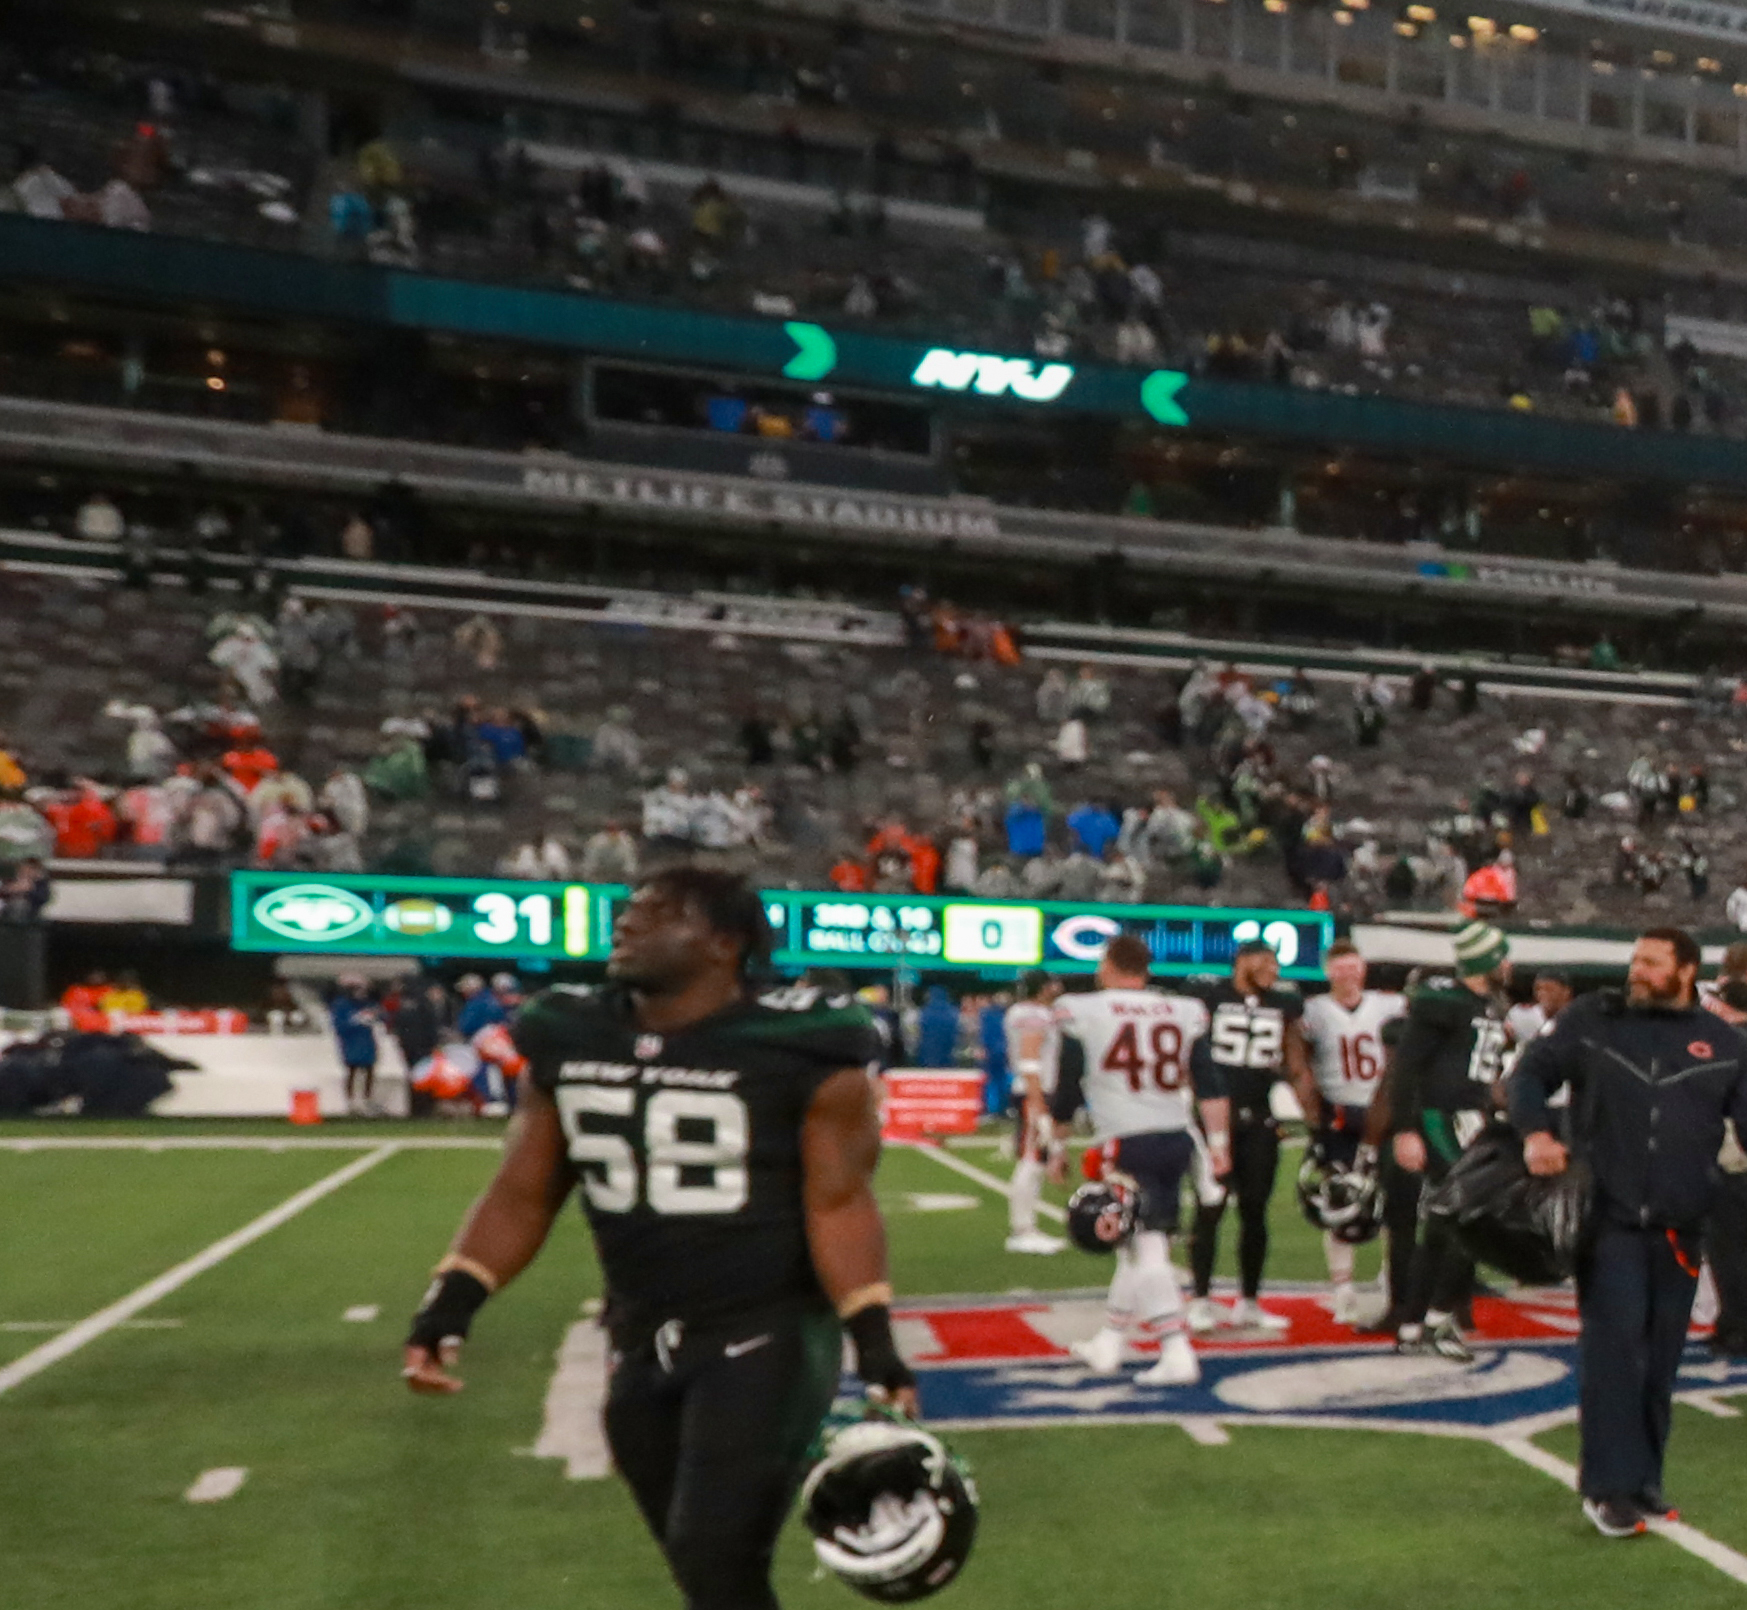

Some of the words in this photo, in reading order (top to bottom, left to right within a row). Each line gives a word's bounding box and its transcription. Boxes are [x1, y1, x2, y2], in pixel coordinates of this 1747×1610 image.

[911, 348, 1075, 401] NYJ
[773, 494, 999, 538] STADIUM
[472, 892, 553, 946] 31
[982, 919, 1003, 949] 0
[1100, 1021, 1184, 1093] 48
[1210, 1013, 1285, 1069] 52
[1340, 1031, 1376, 1082] 16
[555, 1084, 749, 1215] 58
